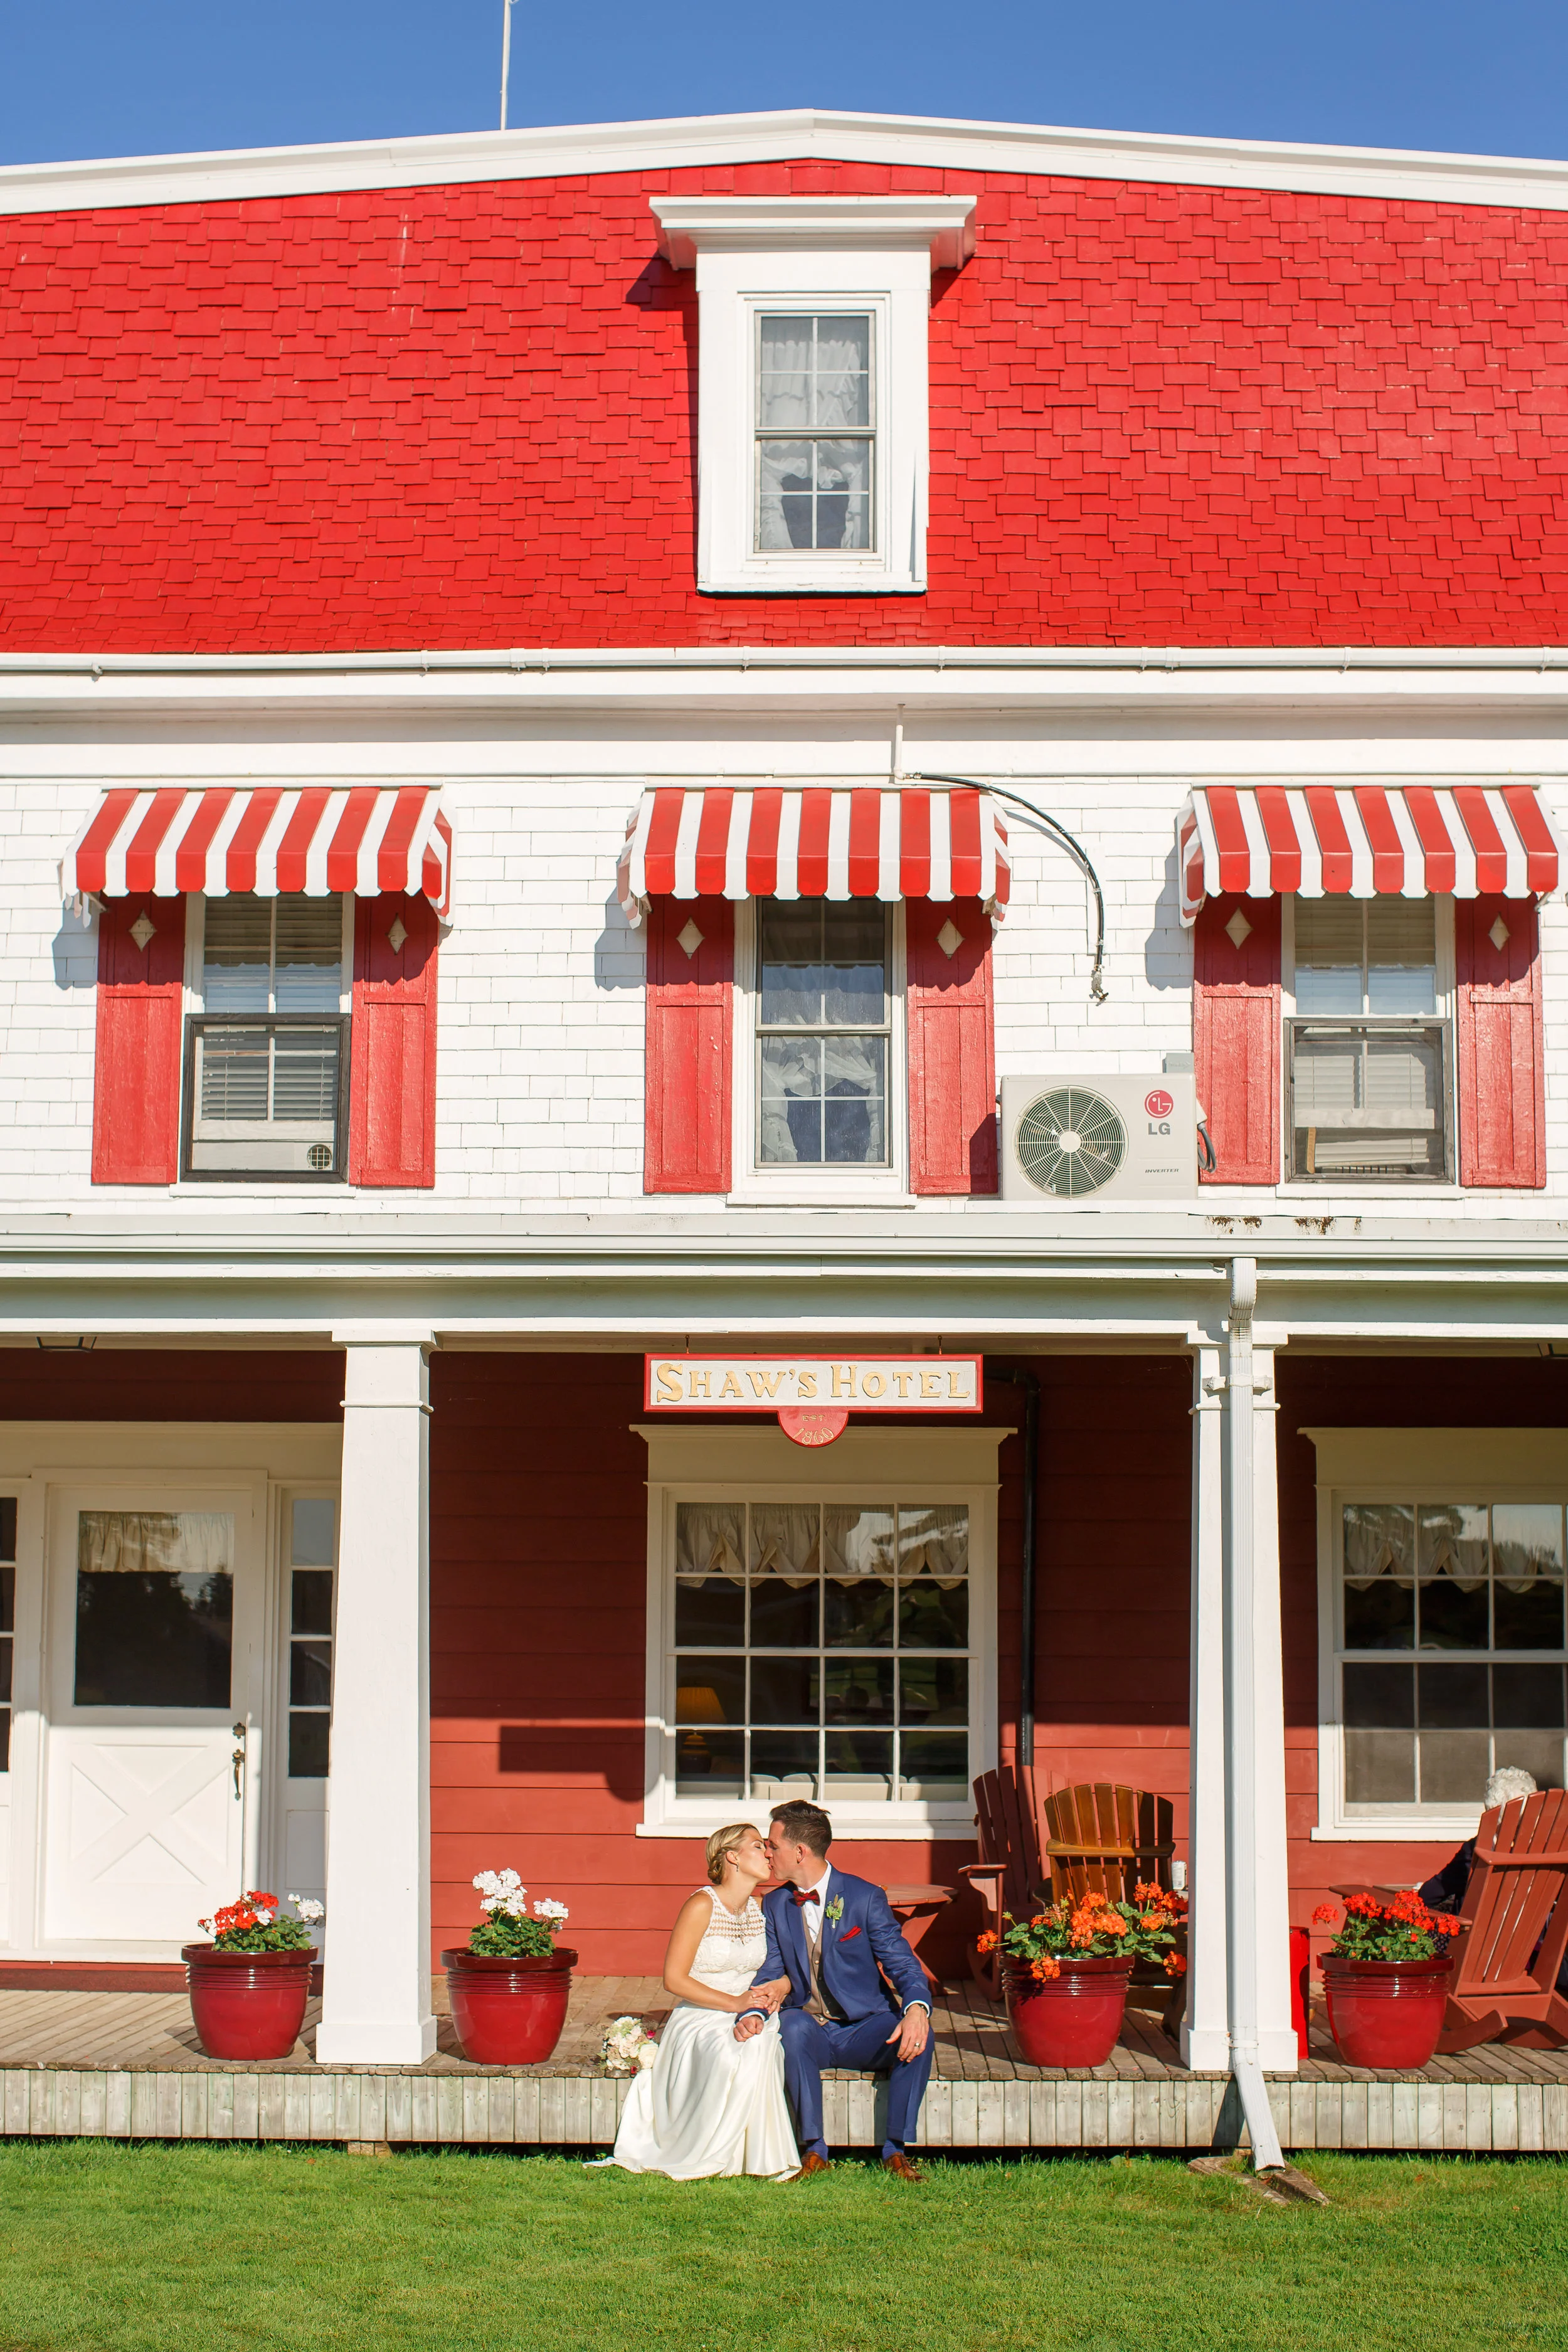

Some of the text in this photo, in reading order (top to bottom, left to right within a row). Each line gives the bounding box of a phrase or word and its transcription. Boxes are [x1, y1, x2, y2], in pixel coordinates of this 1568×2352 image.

[1148, 1122, 1170, 1135] LG
[657, 1363, 971, 1402] SHAW'S HOTEL
[792, 1428, 835, 1445] 1860
